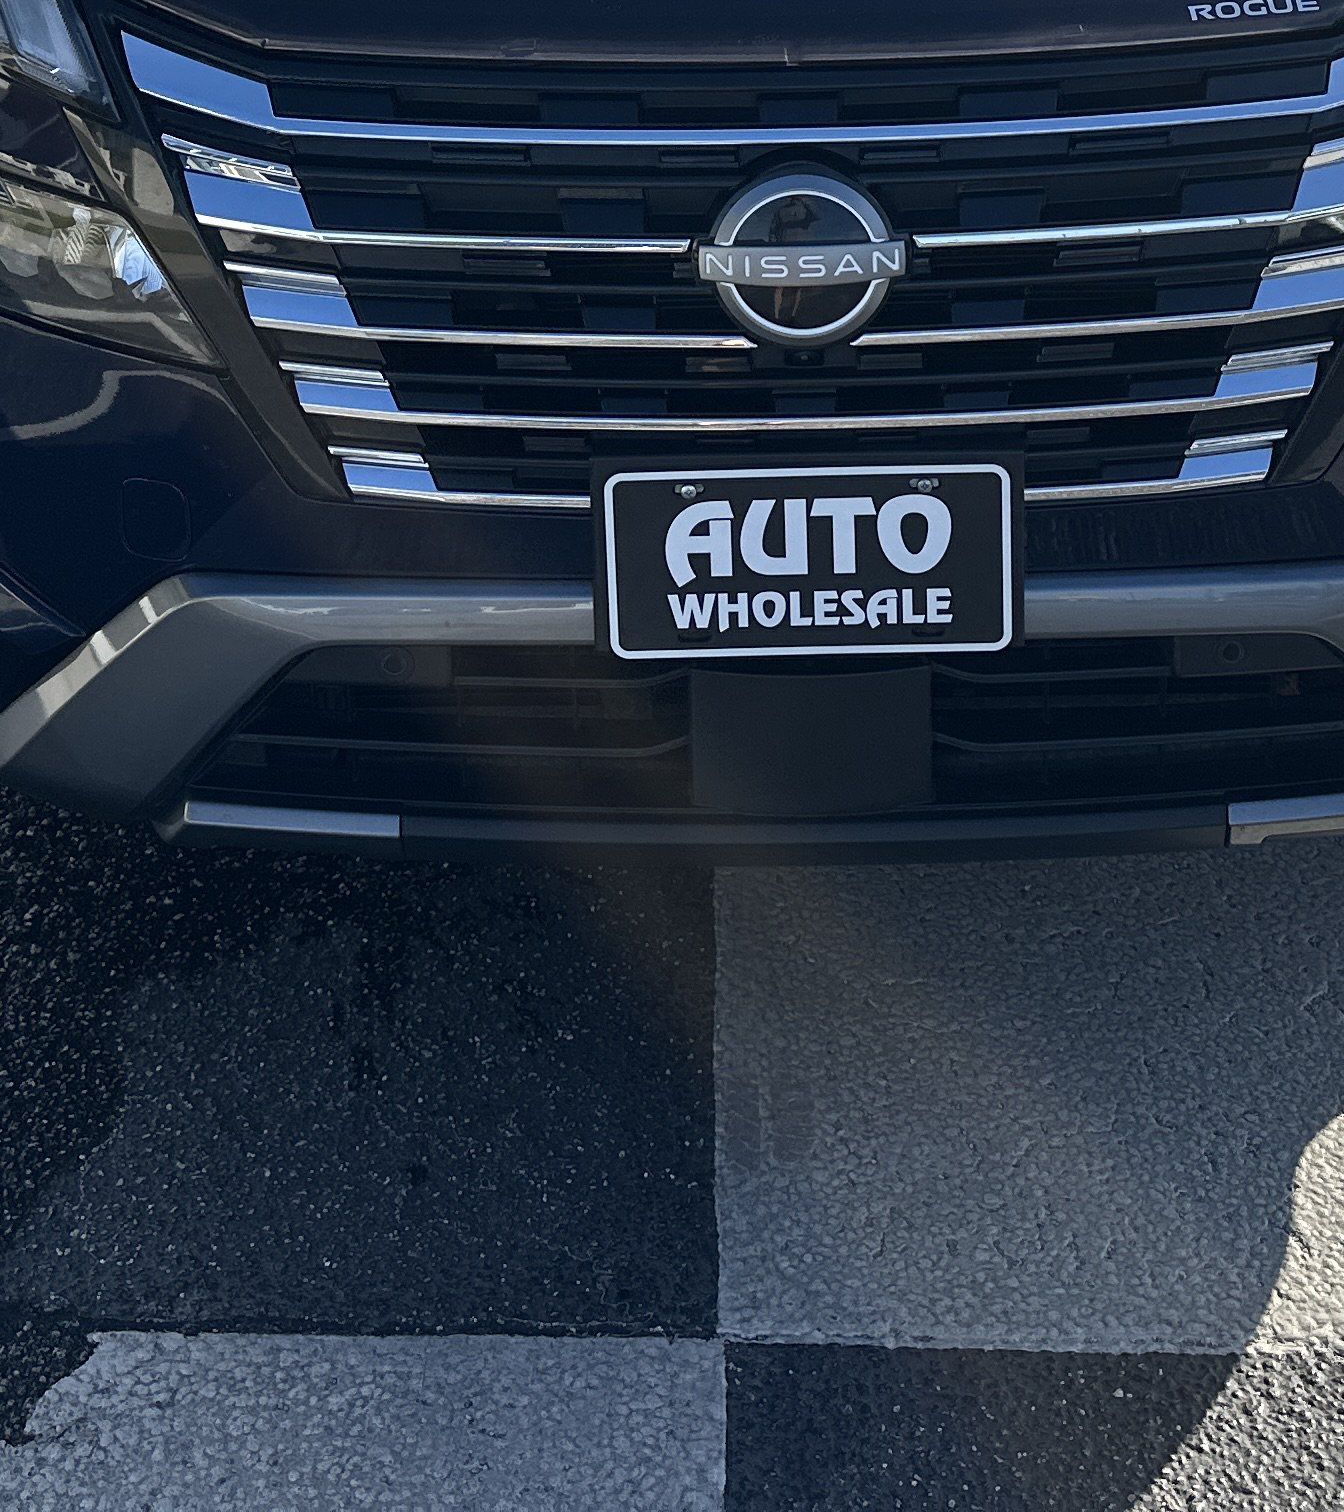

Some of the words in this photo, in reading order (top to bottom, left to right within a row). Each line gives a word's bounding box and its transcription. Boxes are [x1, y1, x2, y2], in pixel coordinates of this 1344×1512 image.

[705, 248, 900, 278] NISSAN
[665, 494, 952, 588] AUTO
[667, 588, 953, 632] WHOLESALE
